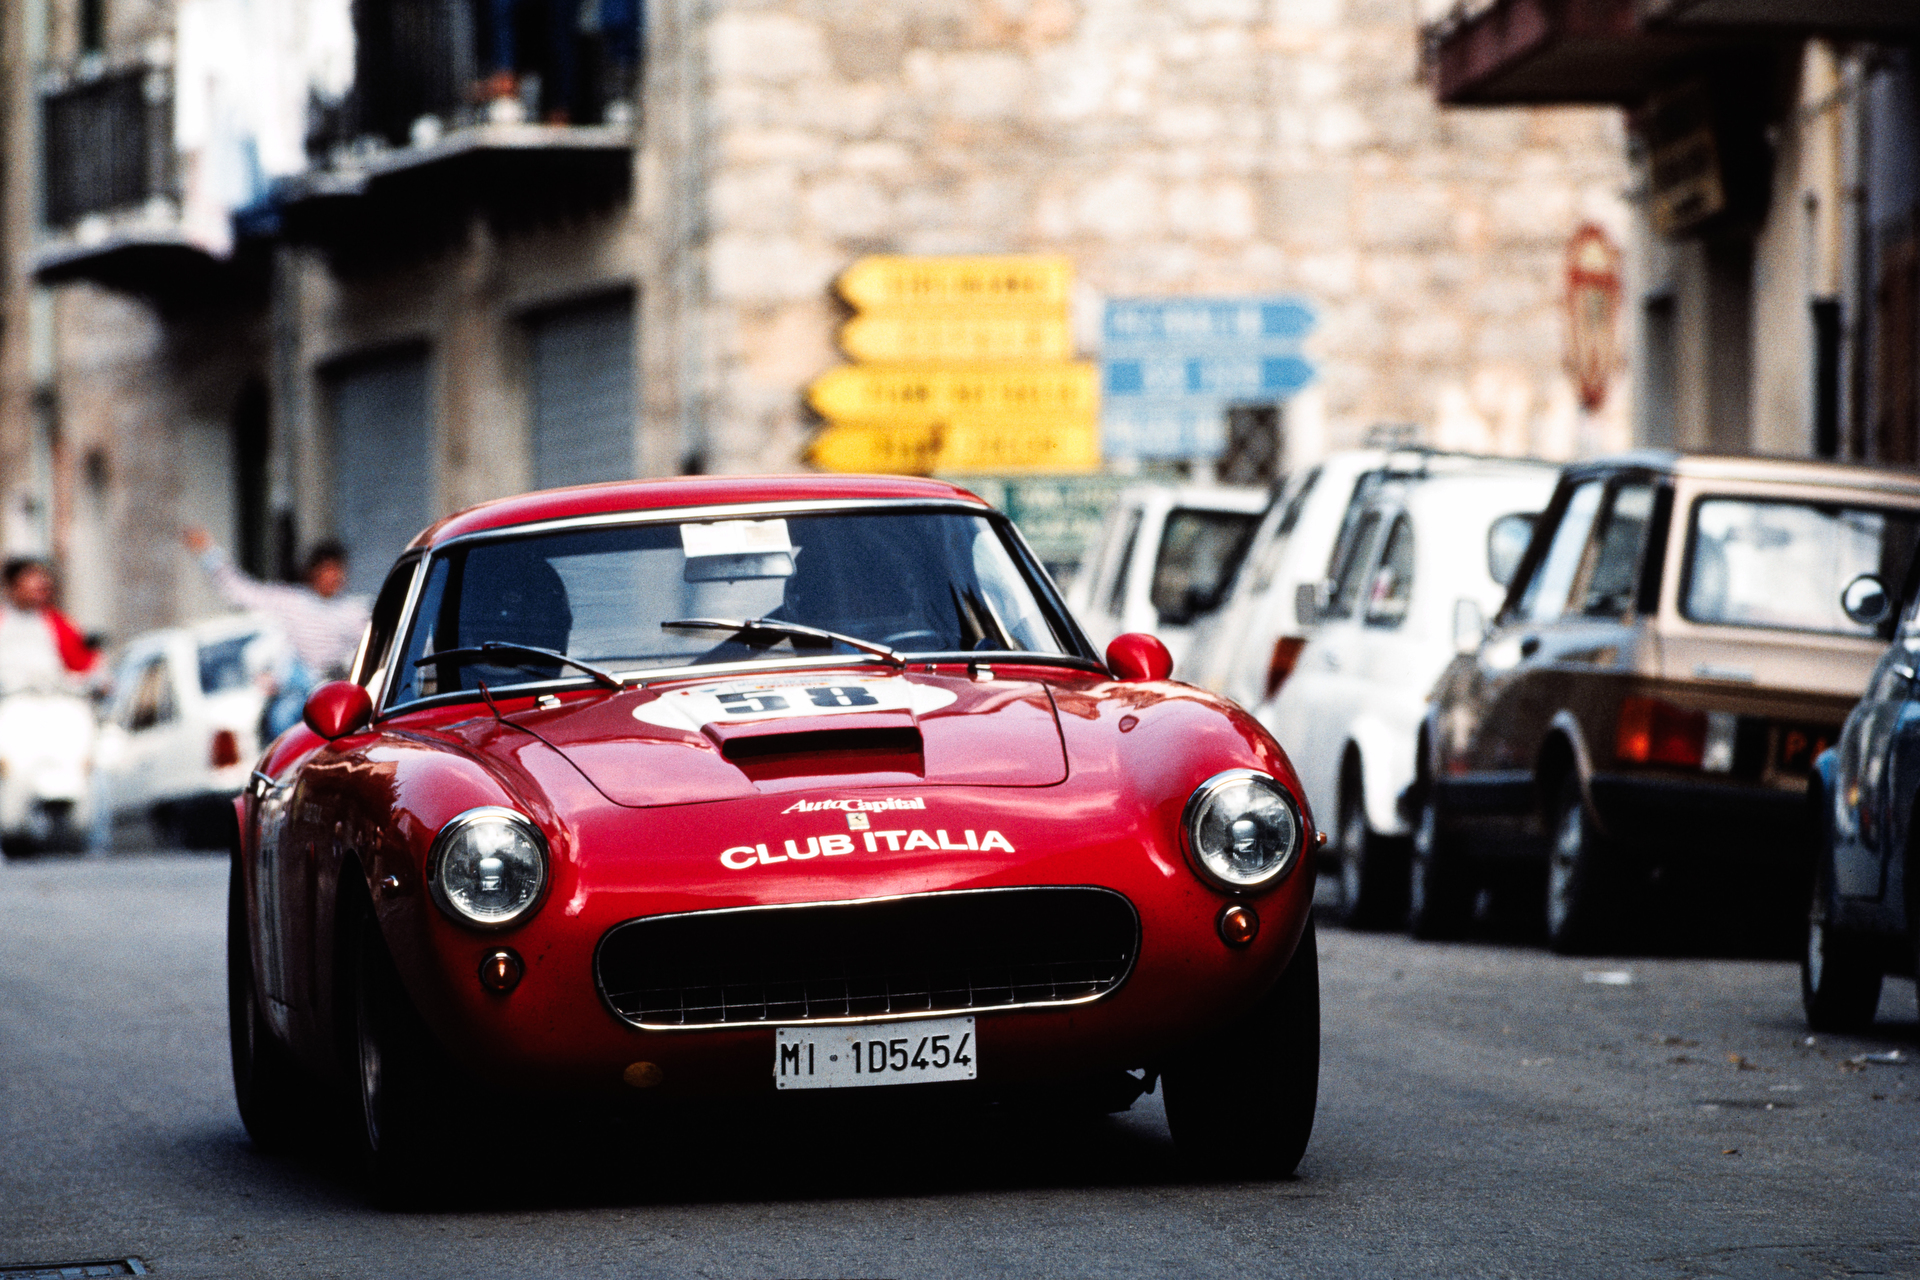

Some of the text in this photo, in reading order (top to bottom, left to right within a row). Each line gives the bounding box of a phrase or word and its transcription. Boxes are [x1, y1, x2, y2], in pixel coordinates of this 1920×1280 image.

[781, 797, 926, 814] AutoCapital
[720, 829, 1015, 869] CLUB ITALIA
[781, 1032, 972, 1075] MI 1D5454
